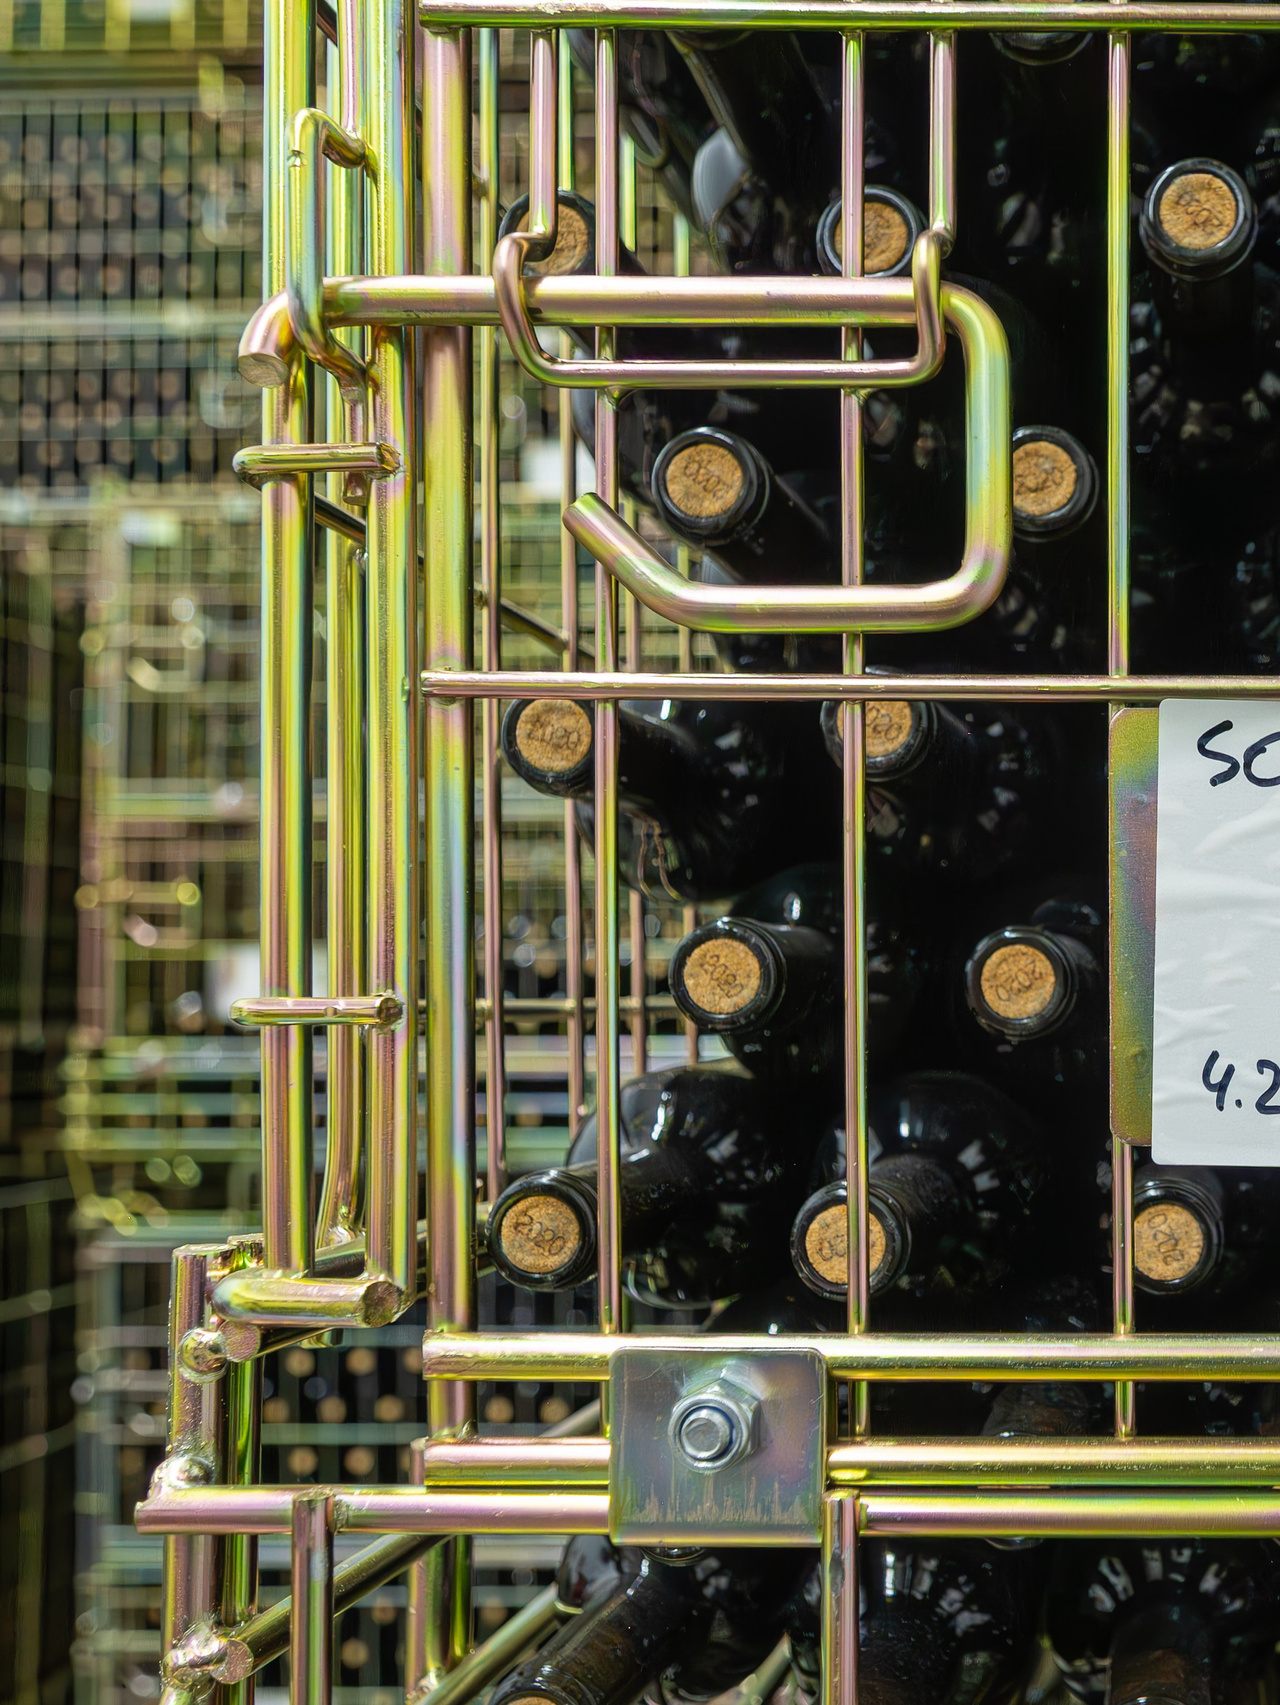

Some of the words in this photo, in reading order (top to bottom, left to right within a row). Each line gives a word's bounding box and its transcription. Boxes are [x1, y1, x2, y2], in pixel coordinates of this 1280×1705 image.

[698, 952, 745, 1000] 2020
[994, 961, 1044, 1004] 2020
[511, 1211, 567, 1257] 2020
[1147, 1212, 1185, 1266] 2020
